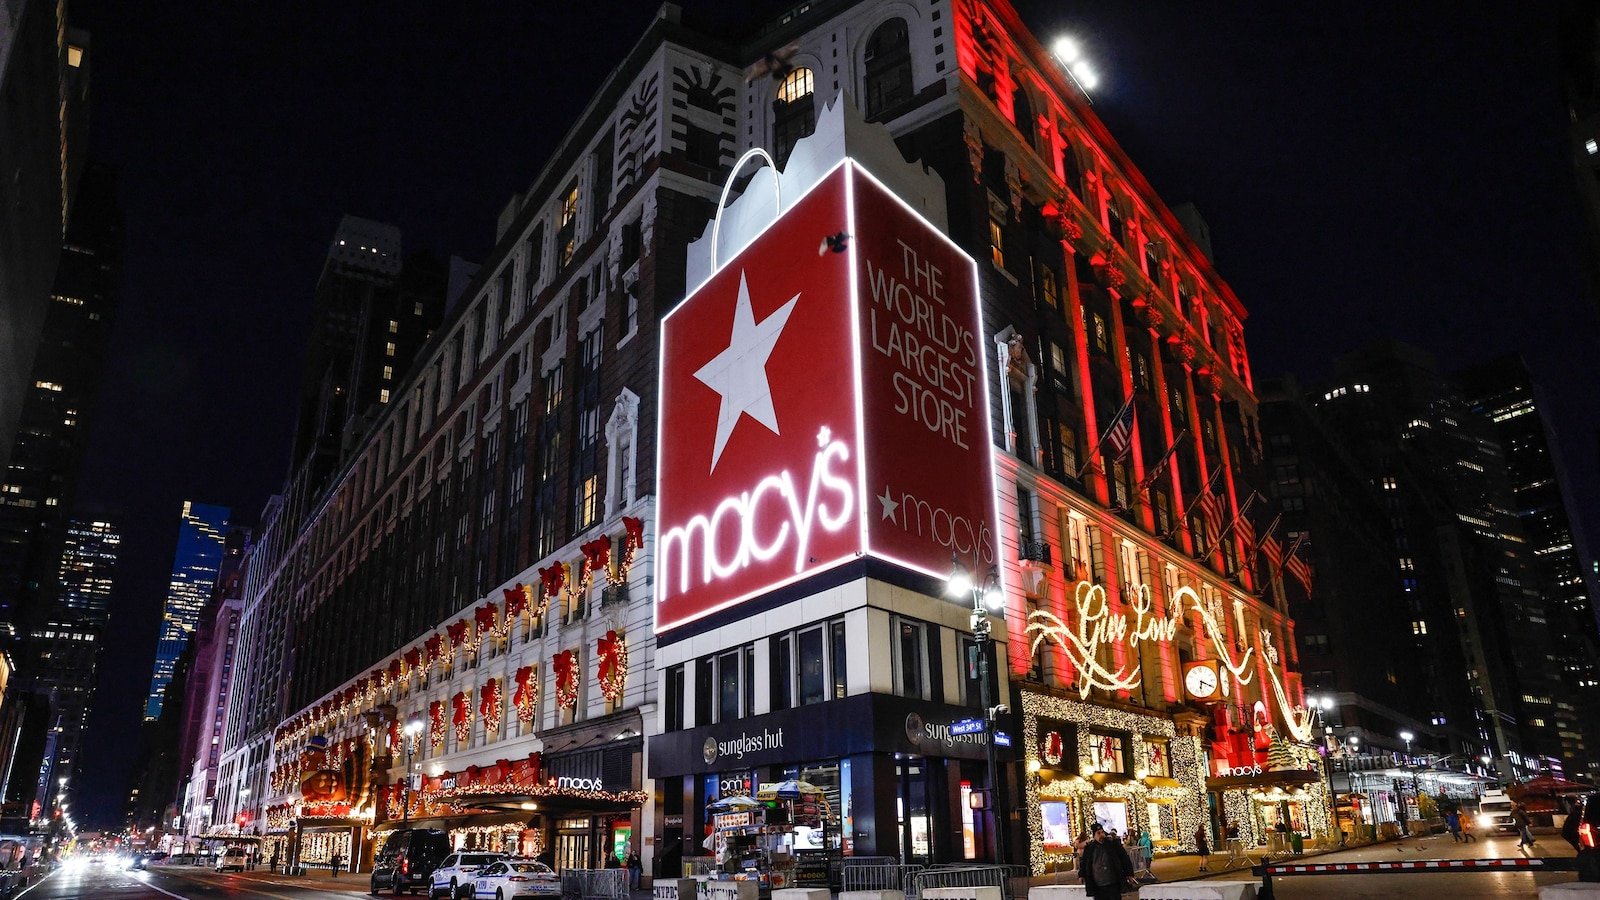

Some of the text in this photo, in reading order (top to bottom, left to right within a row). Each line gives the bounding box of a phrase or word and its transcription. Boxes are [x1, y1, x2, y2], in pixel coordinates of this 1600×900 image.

[897, 238, 945, 305] THE
[866, 259, 976, 367] WORLD'S
[871, 308, 975, 408] LARGEST
[892, 371, 969, 450] STORE
[659, 425, 854, 603] macy's
[902, 492, 993, 566] macy's
[1075, 581, 1176, 655] Give Love
[718, 727, 783, 759] sunglass hut
[925, 720, 973, 747] sung
[952, 725, 965, 735] West
[557, 776, 603, 791] macy's
[656, 886, 676, 899] NYPD
